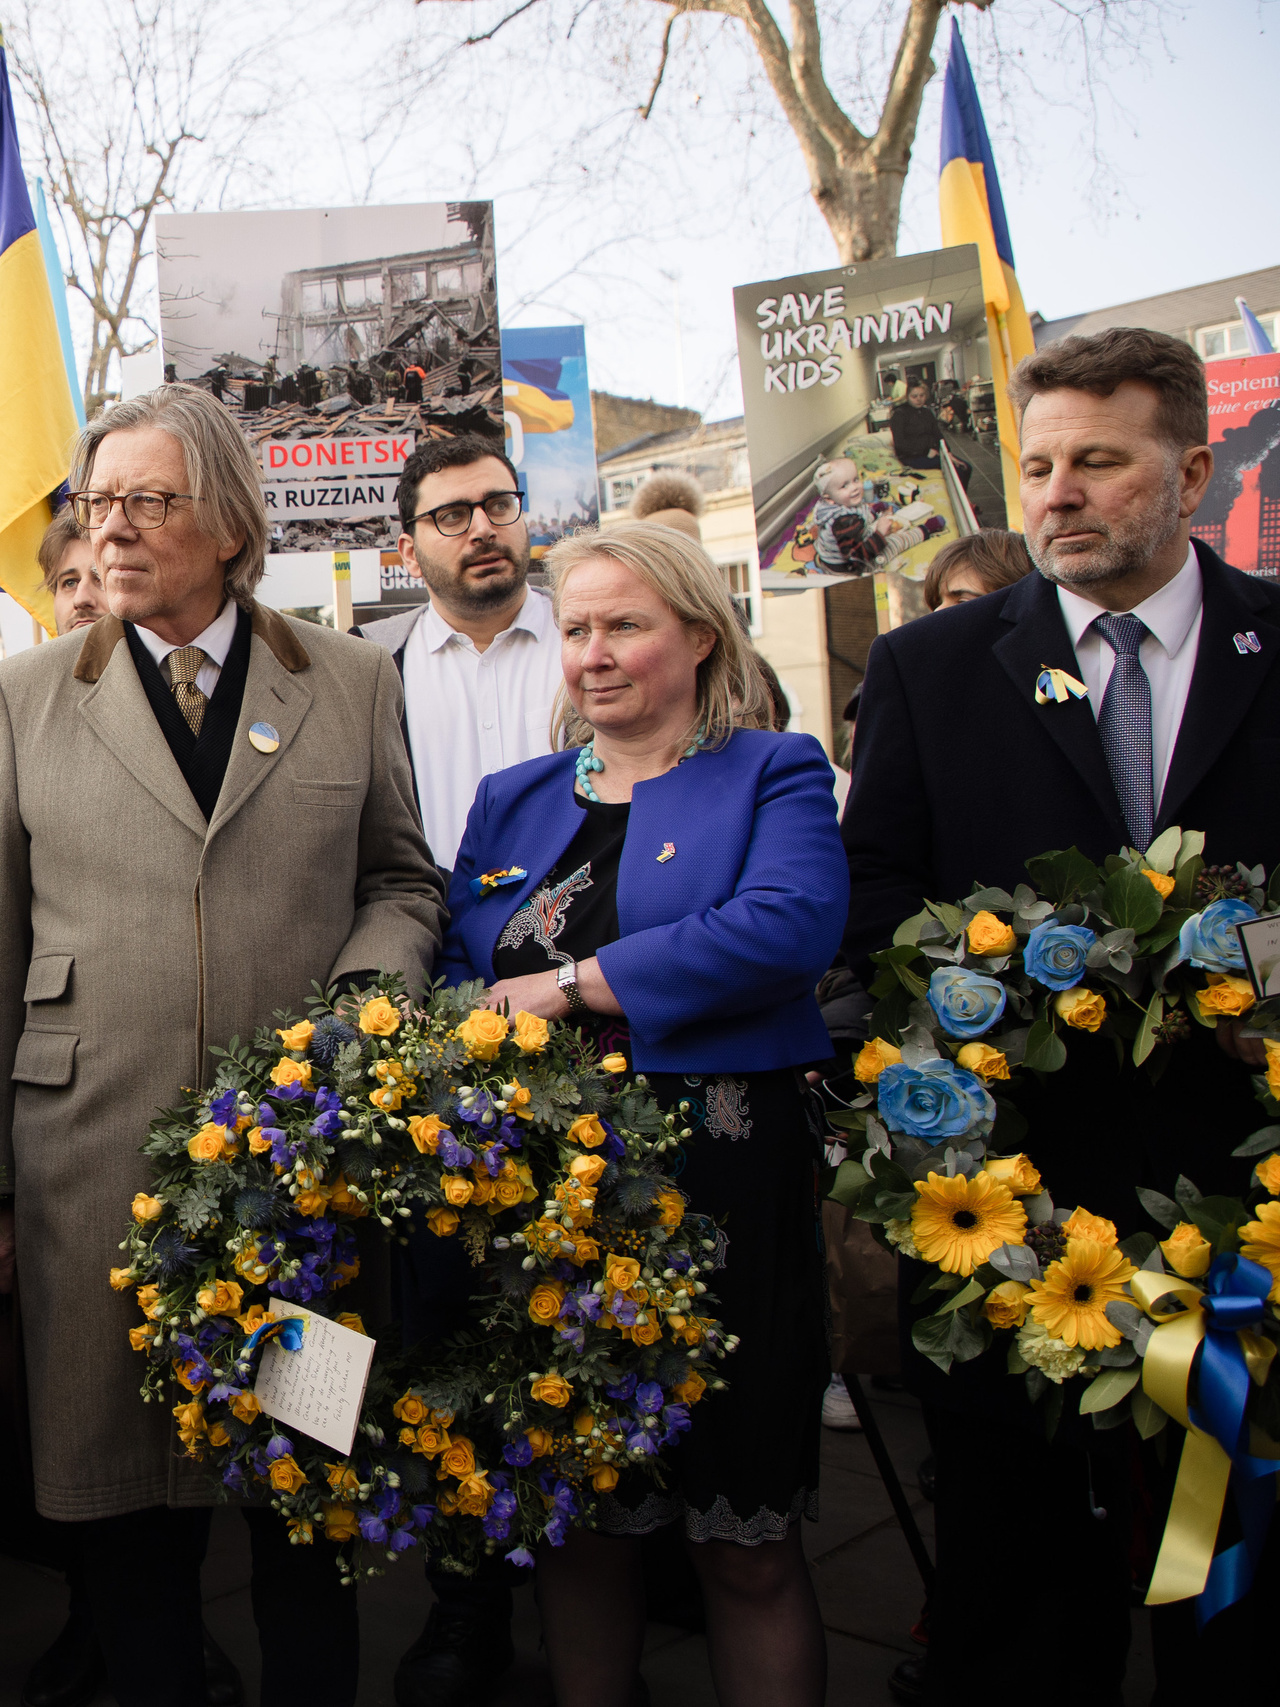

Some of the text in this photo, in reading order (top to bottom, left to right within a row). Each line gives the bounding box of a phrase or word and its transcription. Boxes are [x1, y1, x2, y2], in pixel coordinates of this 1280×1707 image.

[756, 285, 845, 330] SAVE
[760, 302, 953, 361] UKRAINIAN
[763, 355, 842, 394] KIDS
[1243, 398, 1280, 412] ever
[269, 439, 410, 468] DONETSK
[285, 485, 385, 508] RUZZIAN
[381, 577, 427, 590] UKR
